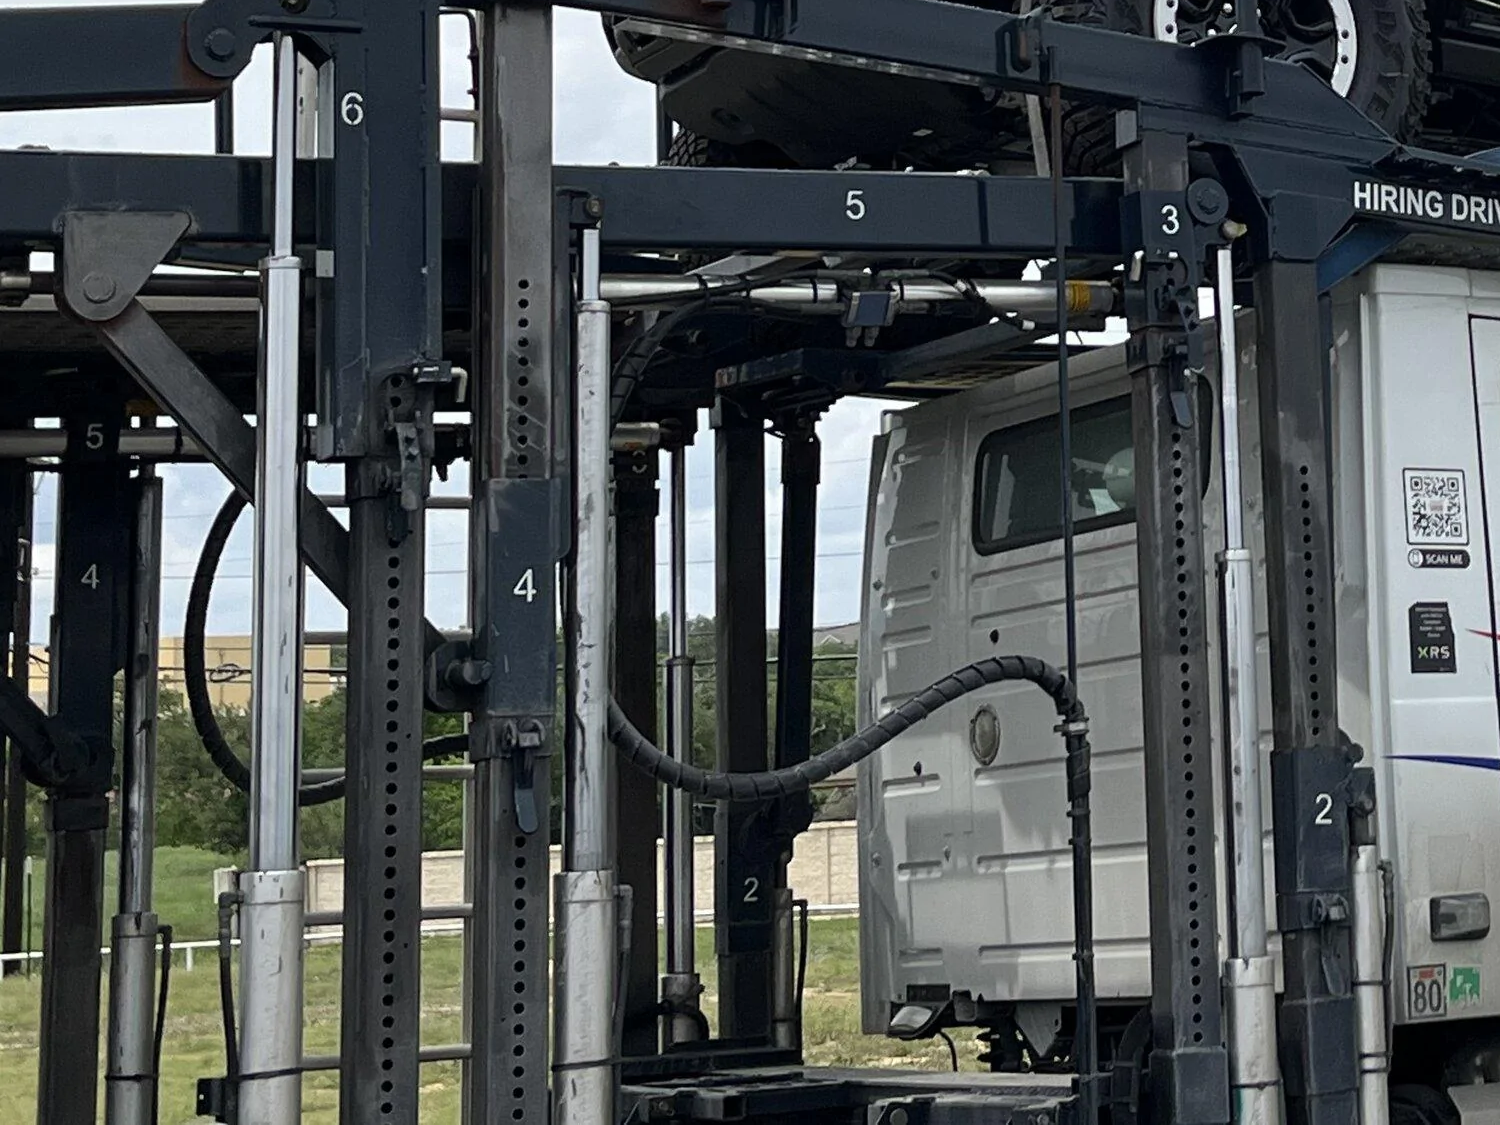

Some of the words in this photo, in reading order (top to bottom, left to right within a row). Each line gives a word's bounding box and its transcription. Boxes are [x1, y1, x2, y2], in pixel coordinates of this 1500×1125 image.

[341, 92, 364, 125] 6
[846, 190, 865, 220] 5
[1353, 181, 1444, 219] HIRING
[1161, 205, 1180, 234] 3
[85, 424, 104, 449] 5
[1425, 553, 1449, 565] SCAN
[1449, 553, 1463, 565] ME
[80, 563, 100, 590] 4
[513, 568, 537, 603] 4
[1417, 645, 1450, 659] XRS
[1315, 793, 1333, 825] 2
[743, 876, 759, 902] 2
[1413, 978, 1442, 1014] 80
